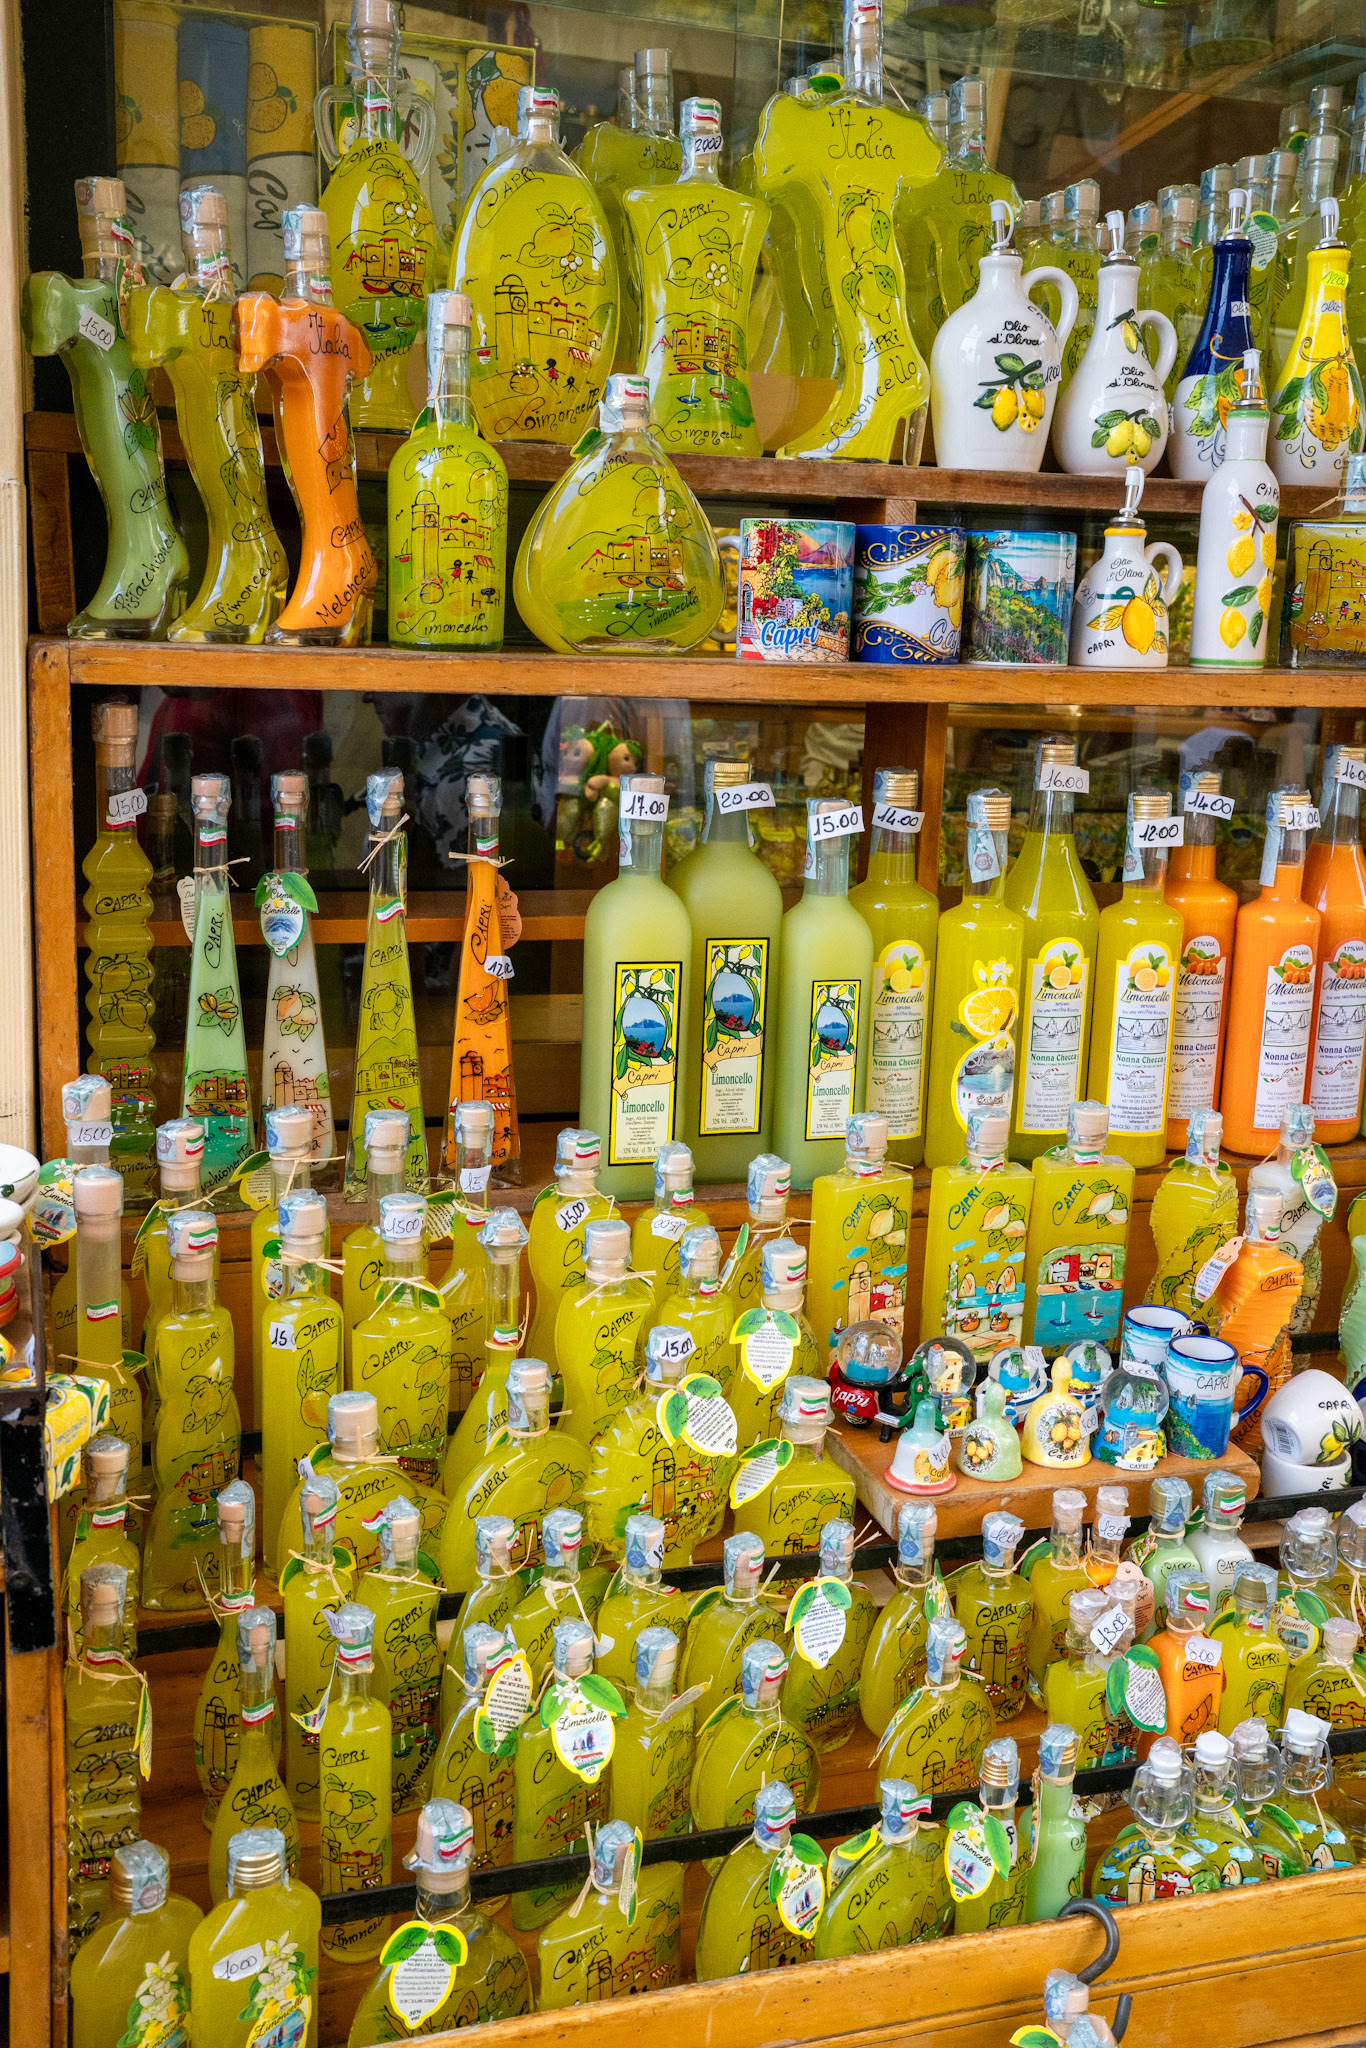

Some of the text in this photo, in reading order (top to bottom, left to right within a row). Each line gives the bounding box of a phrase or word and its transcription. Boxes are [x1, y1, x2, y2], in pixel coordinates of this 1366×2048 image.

[828, 109, 896, 161] Italia
[1003, 319, 1030, 333] Olio
[308, 313, 352, 360] Italia
[986, 331, 1045, 347] d'Oliva
[1120, 366, 1146, 379] Olio
[1106, 376, 1159, 392] d'Oliva
[1110, 557, 1132, 570] Olio
[1106, 567, 1145, 582] d'Oliva
[760, 618, 820, 655] Capri
[1087, 640, 1116, 654] CAPRI
[1042, 769, 1084, 790] 16.00
[625, 795, 665, 817] 17.00
[721, 790, 770, 809] 20.00
[813, 812, 859, 835] 15.00
[877, 807, 919, 827] 14.00
[1139, 823, 1179, 842] 12.00
[270, 888, 294, 901] Crema
[262, 905, 301, 917] Limoncello
[875, 991, 925, 1005] Limoncello
[1034, 988, 1083, 1002] Limoncello
[1119, 989, 1170, 1004] Limoncello
[718, 1041, 749, 1058] Capri
[1173, 1043, 1216, 1051] onna Checca
[1319, 1045, 1362, 1054] Nonna Checca
[872, 1058, 920, 1067] Nonna Checca
[1030, 1053, 1077, 1062] Nonna Checca
[1116, 1054, 1164, 1064] Nonna Checca
[1264, 1052, 1289, 1061] Nonna
[821, 1059, 845, 1072] Capri
[628, 1069, 661, 1087] Capri
[711, 1073, 753, 1086] Limoncello
[812, 1085, 850, 1097] Limoncello
[621, 1100, 665, 1114] Limoncello
[39, 1185, 75, 1208] Limonce
[832, 1387, 870, 1409] Capri
[1048, 1449, 1079, 1462] Capri
[1273, 1614, 1311, 1632] Limoncello
[558, 1711, 608, 1732] Limoncello
[953, 1832, 993, 1868] Limoncello
[783, 1868, 817, 1900] Limoncello
[254, 1996, 304, 2039] Limoncello
